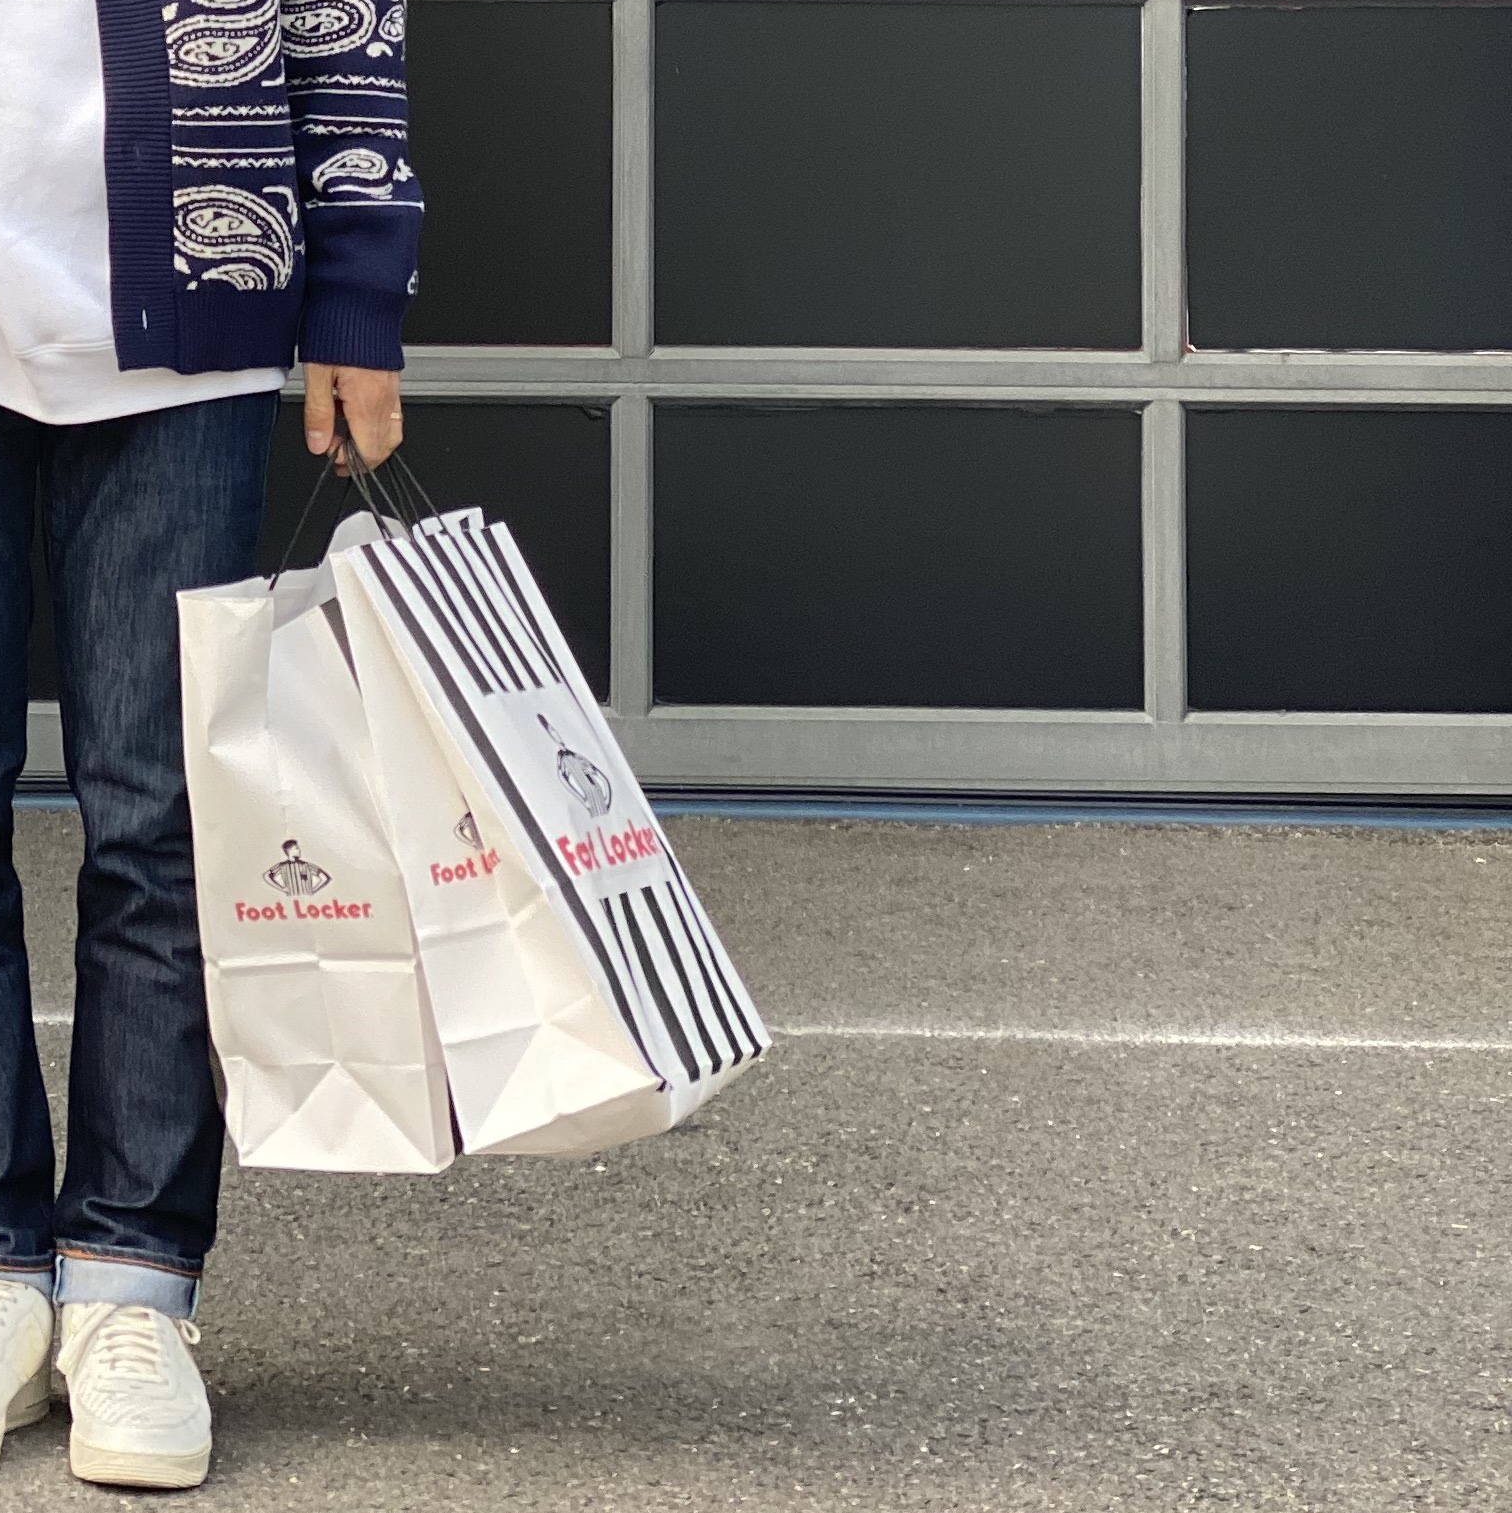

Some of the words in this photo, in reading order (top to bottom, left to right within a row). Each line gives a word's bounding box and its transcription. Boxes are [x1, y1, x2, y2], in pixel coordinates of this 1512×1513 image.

[597, 818, 661, 866] Locke
[430, 857, 478, 886] Foot
[235, 901, 288, 922] Foot
[293, 898, 373, 920] Locker
